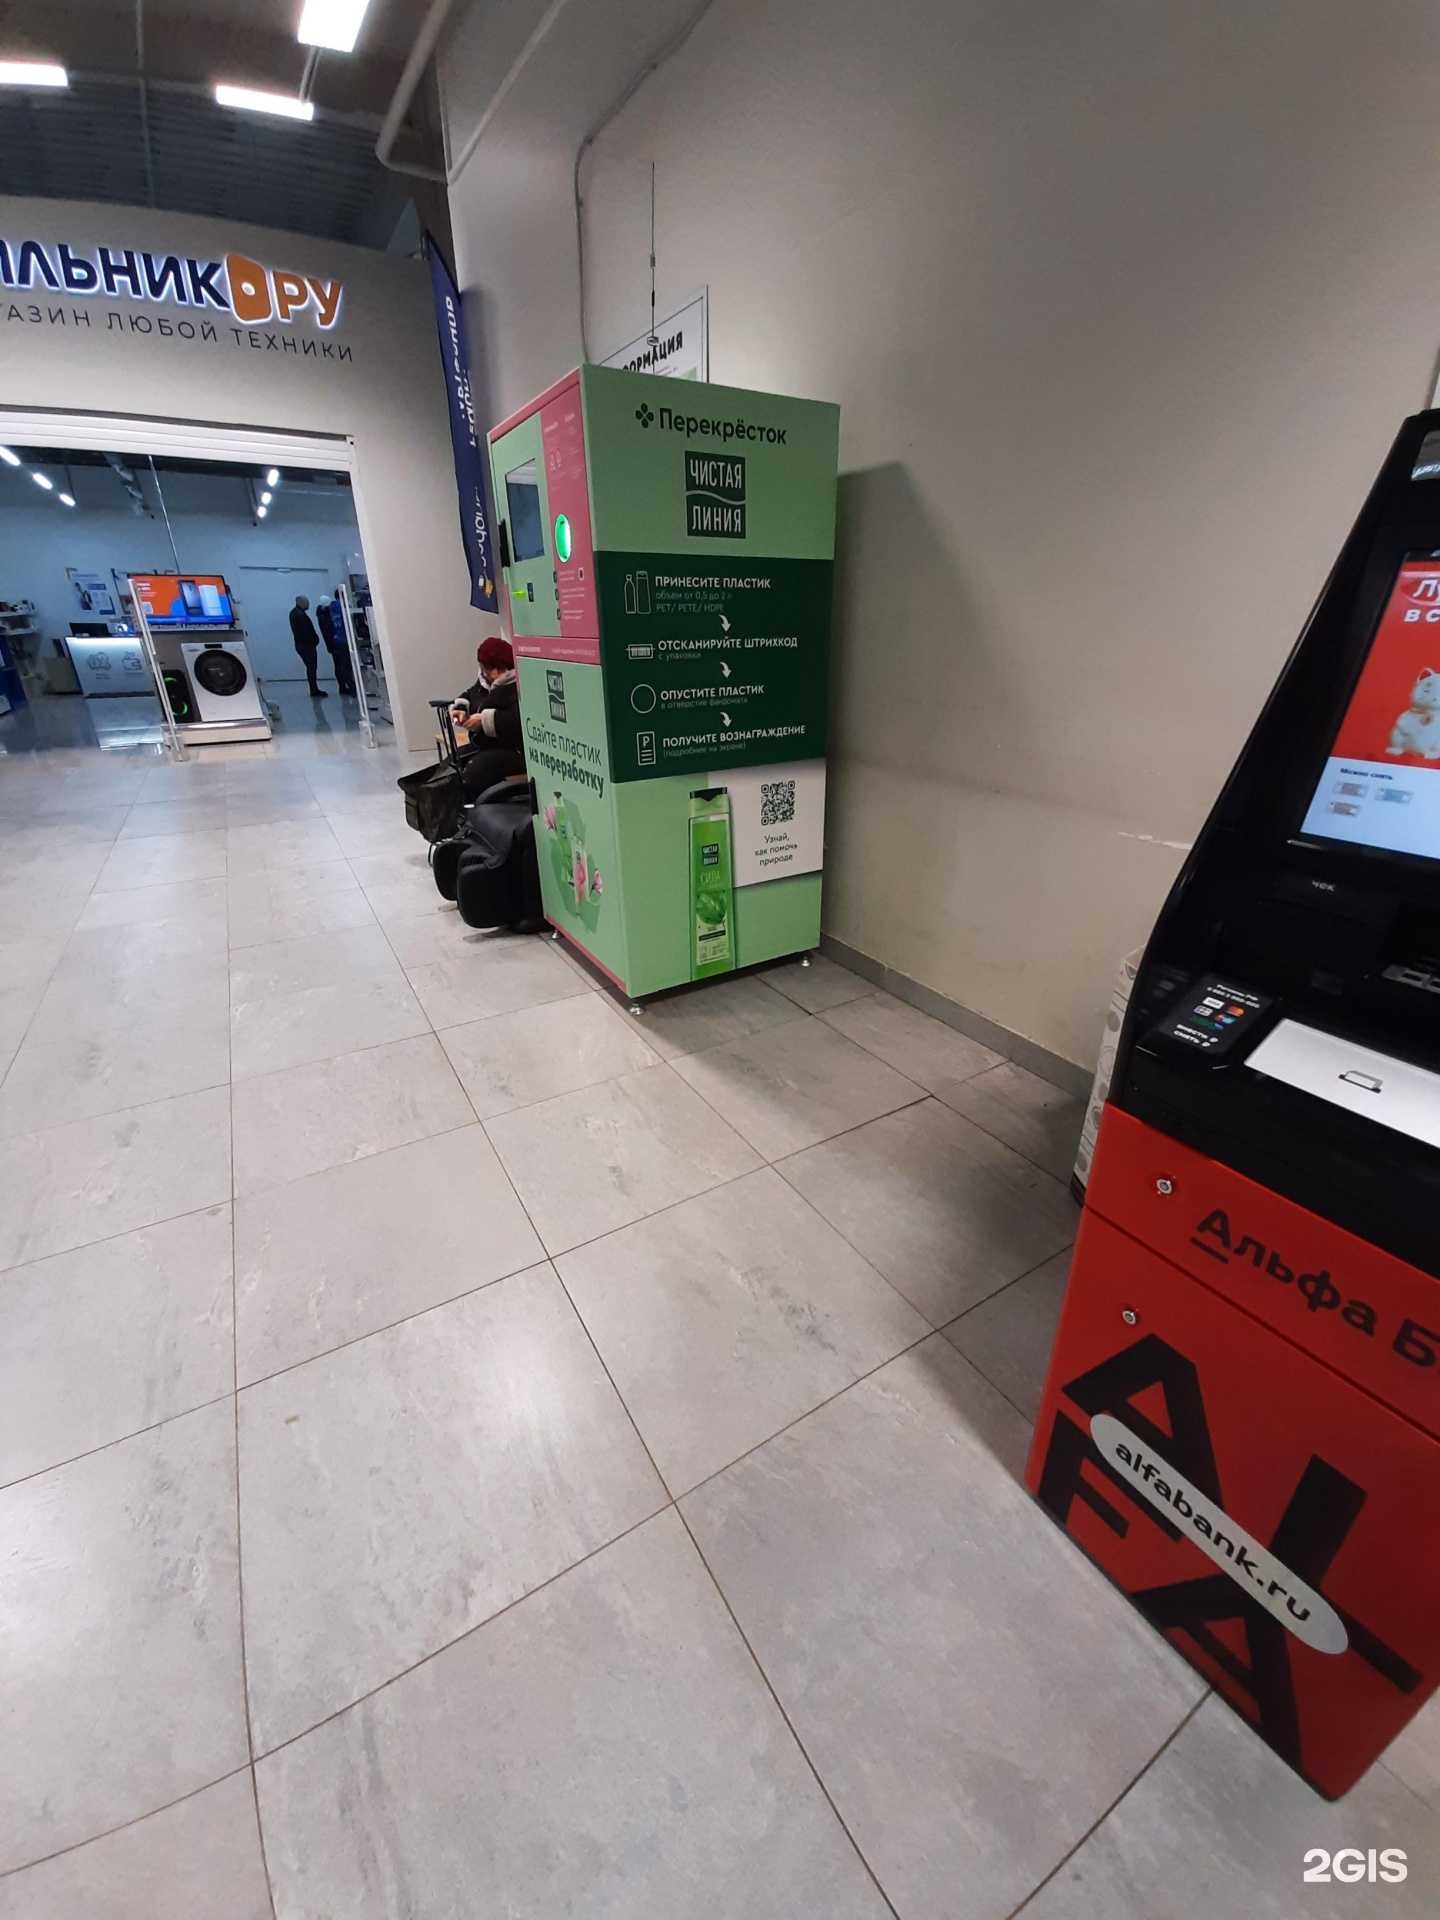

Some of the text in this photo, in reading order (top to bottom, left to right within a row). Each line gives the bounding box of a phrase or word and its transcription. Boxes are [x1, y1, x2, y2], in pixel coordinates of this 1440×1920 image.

[106, 312, 217, 342] ЛЮБОЙ
[231, 328, 353, 362] ТЕХНИКИ
[659, 407, 787, 445] Перекрёсток
[690, 459, 742, 489] ЧИСТАЯ
[692, 505, 742, 532] ЛИНИЯ
[655, 576, 771, 589] ПРИНЕСИТЕ ПЛАСТИК
[658, 636, 798, 651] ОТСКАНИРУЙТЕ ШТРИХКОД
[660, 684, 765, 701] ОПУСТИТЕ ПЛАСТИК
[526, 717, 602, 767] Сдайте пластик
[663, 725, 806, 748] ПОЛУЧИТЕ ВОЗНАГРАЖДЕНИЕ
[529, 746, 604, 800] на переработку
[1192, 1209, 1440, 1369] Альфа Б
[1115, 1438, 1312, 1624] alfabank.ru
